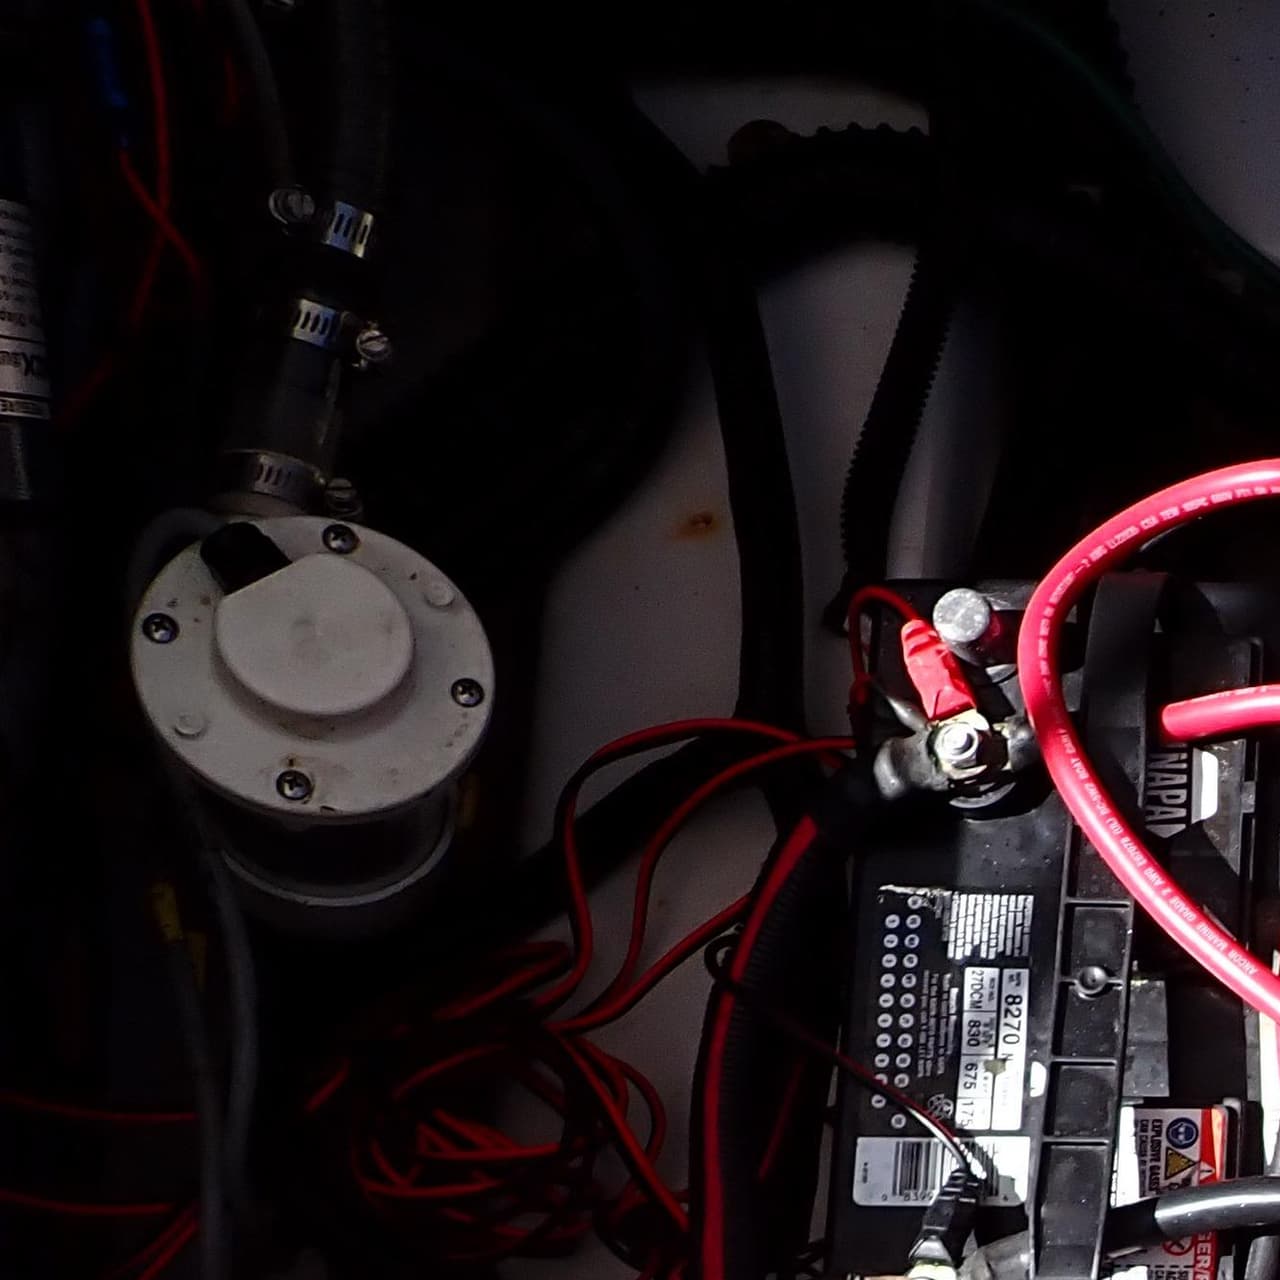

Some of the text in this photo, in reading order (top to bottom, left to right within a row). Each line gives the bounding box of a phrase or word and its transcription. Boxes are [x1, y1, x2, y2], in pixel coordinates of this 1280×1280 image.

[1145, 753, 1188, 821] NAPA
[969, 970, 984, 1009] 27DCM
[967, 1020, 980, 1047] 830
[1003, 994, 1022, 1045] 8270
[964, 1063, 978, 1090] 675
[1150, 1119, 1162, 1163] EXPLOSIVE
